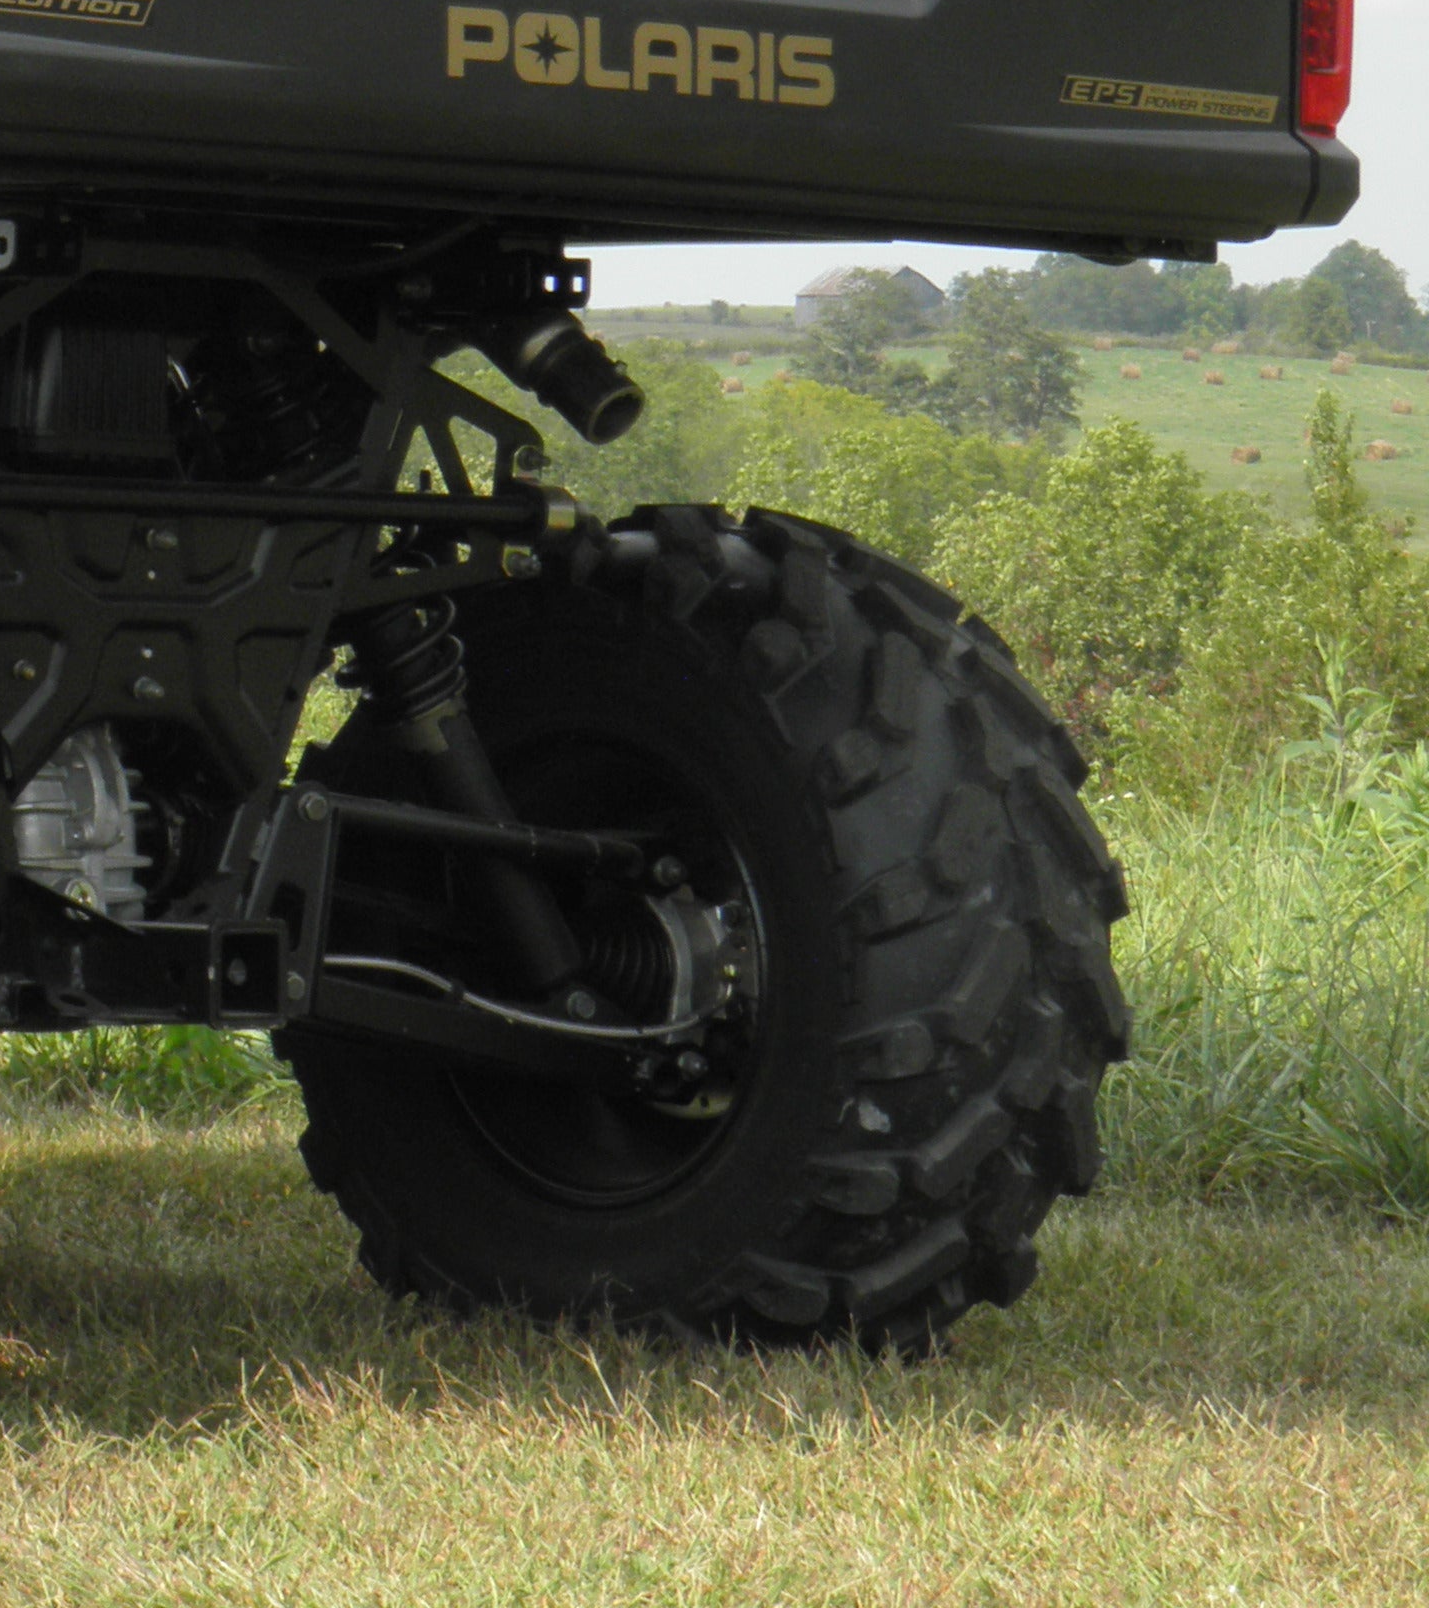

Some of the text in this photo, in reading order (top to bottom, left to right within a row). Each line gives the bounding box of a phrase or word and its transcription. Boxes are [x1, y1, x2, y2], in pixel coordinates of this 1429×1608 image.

[447, 5, 835, 107] POLARIS
[1069, 80, 1137, 106] EPS
[1144, 95, 1270, 120] POWER STEERING
